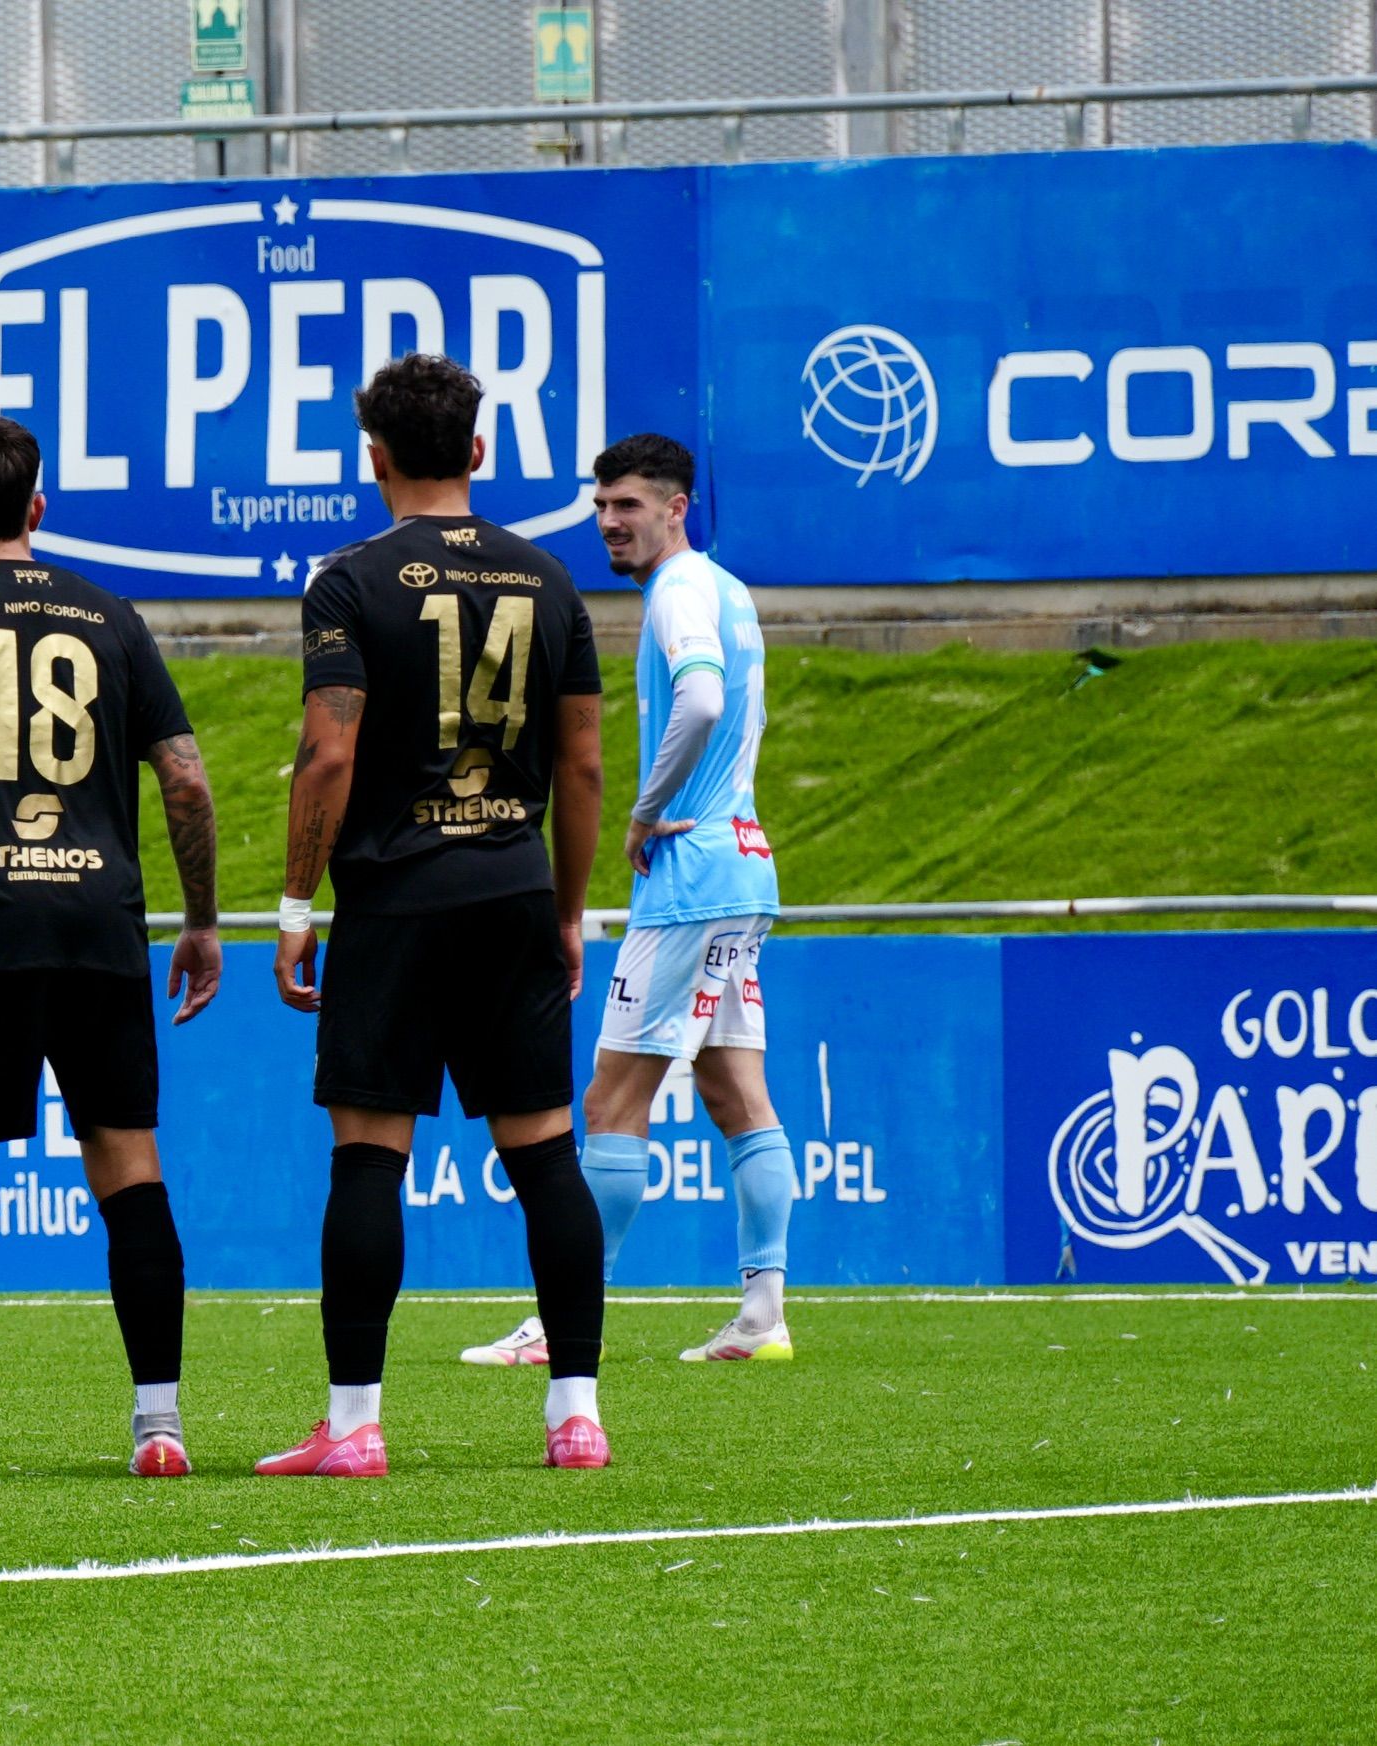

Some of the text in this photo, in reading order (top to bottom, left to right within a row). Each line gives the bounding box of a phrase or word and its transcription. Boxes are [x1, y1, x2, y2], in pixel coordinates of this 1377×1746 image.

[256, 235, 316, 274] Food
[211, 487, 356, 531] Experience
[445, 569, 542, 588] NIMO GORDILLO
[4, 601, 105, 624] NIMO GORDILLO
[419, 594, 534, 751] 14
[413, 796, 527, 825] STHENOS
[705, 945, 722, 967] EL
[406, 1145, 465, 1206] LA
[646, 1139, 723, 1202] DEL
[790, 1140, 887, 1203] PEL
